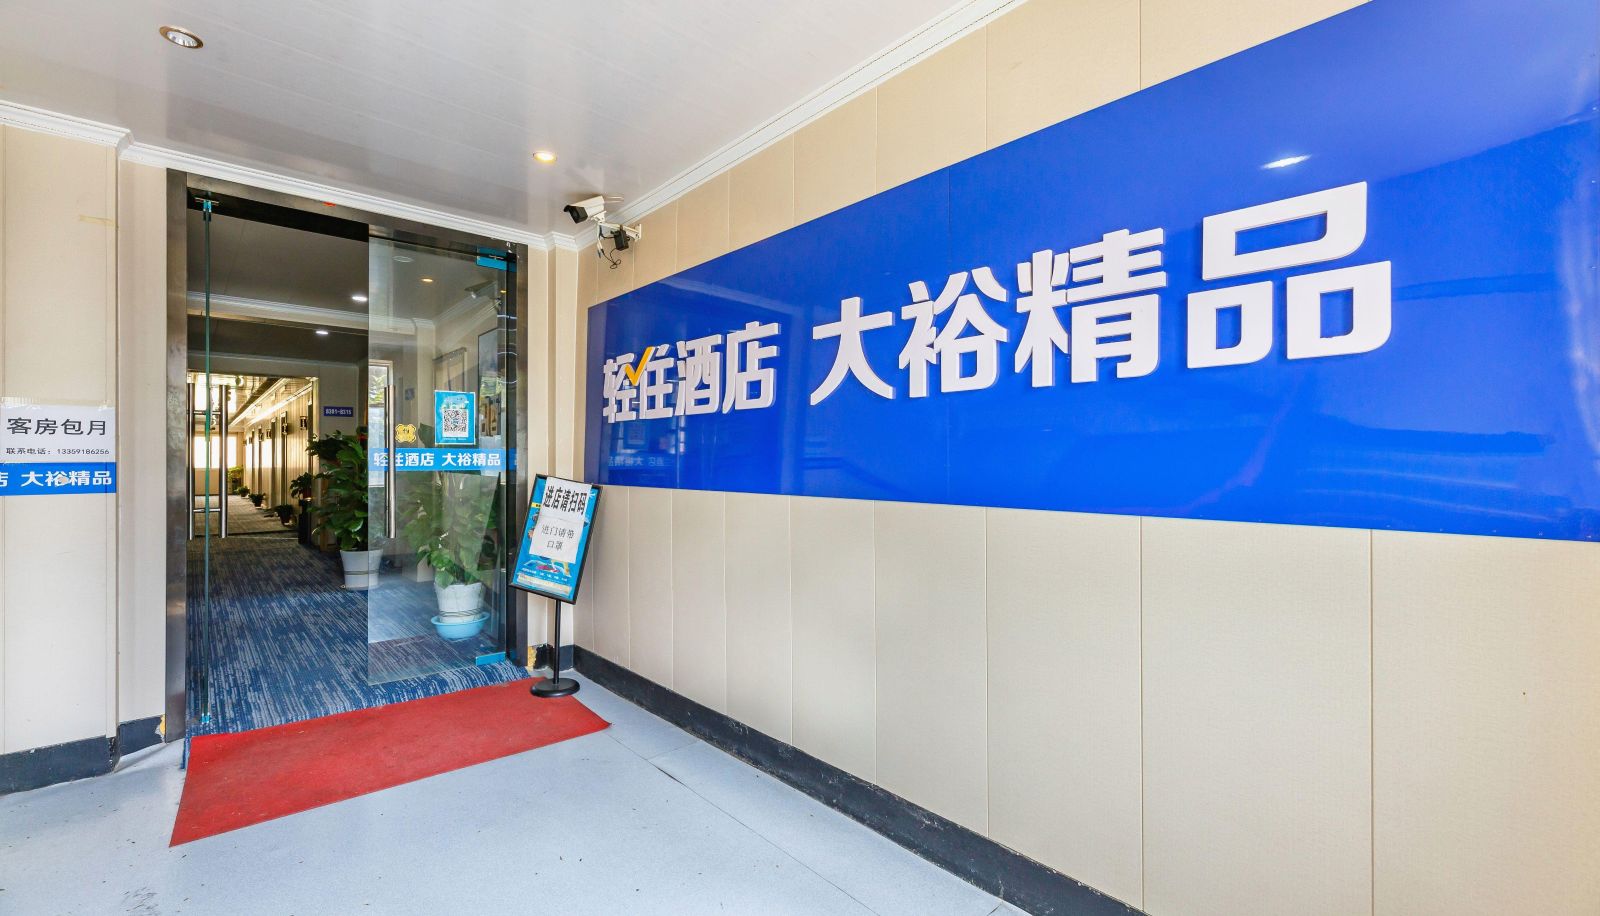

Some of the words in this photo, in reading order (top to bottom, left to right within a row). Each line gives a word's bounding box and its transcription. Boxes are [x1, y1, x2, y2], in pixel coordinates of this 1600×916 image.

[603, 321, 780, 424] 轻住酒店
[810, 181, 1392, 405] 大裕精品
[7, 417, 106, 435] 客房包月
[442, 453, 500, 466] 大裕精品
[21, 470, 112, 487] 大裕精品
[543, 485, 587, 514] 进店请扫码
